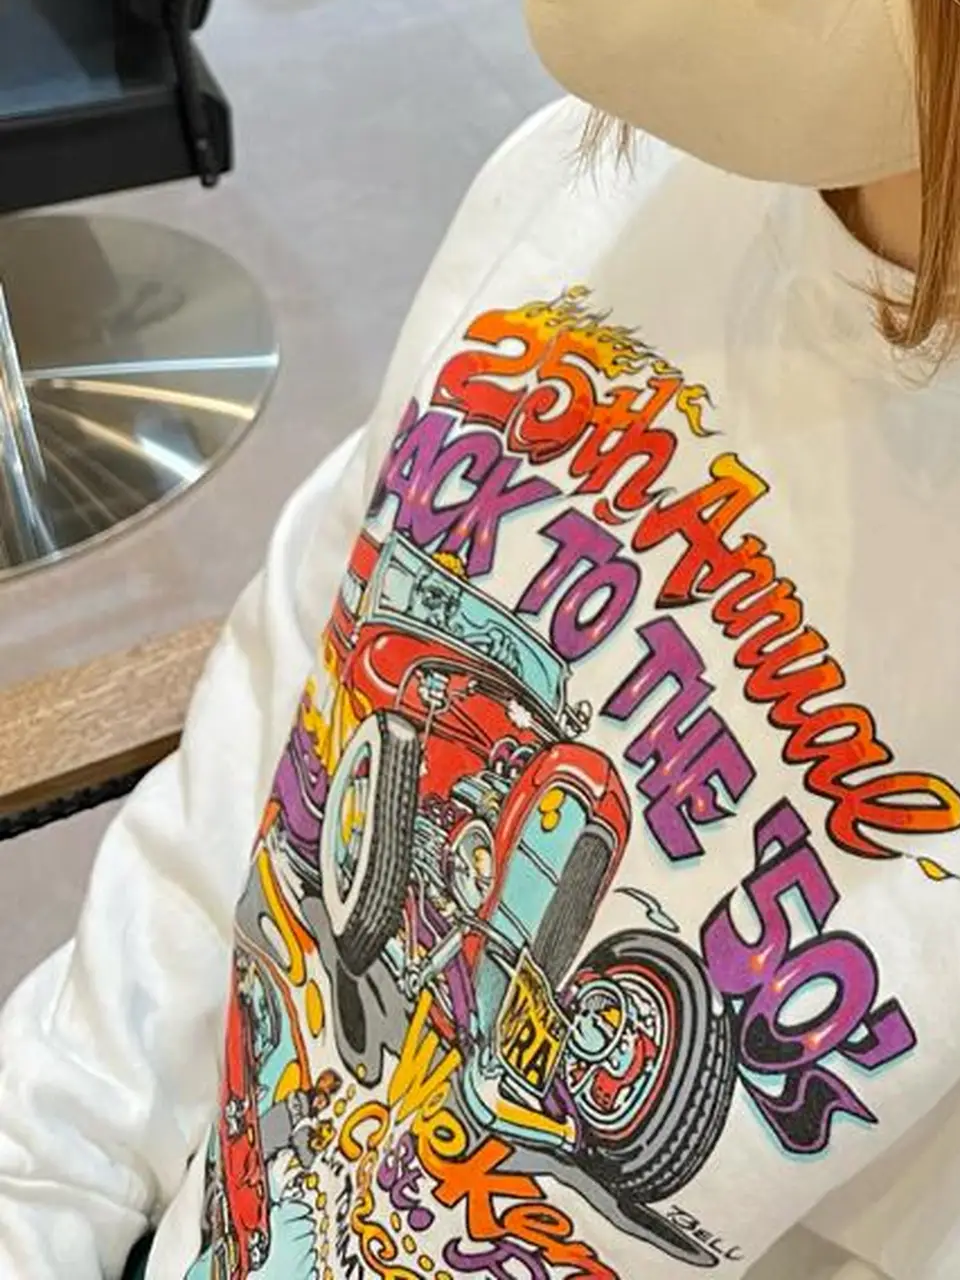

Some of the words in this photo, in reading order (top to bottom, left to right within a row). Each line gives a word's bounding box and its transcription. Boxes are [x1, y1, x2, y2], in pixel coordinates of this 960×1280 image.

[430, 302, 684, 525] 25th
[367, 397, 562, 578] ACK
[516, 507, 642, 661] TO
[600, 616, 756, 862] THE
